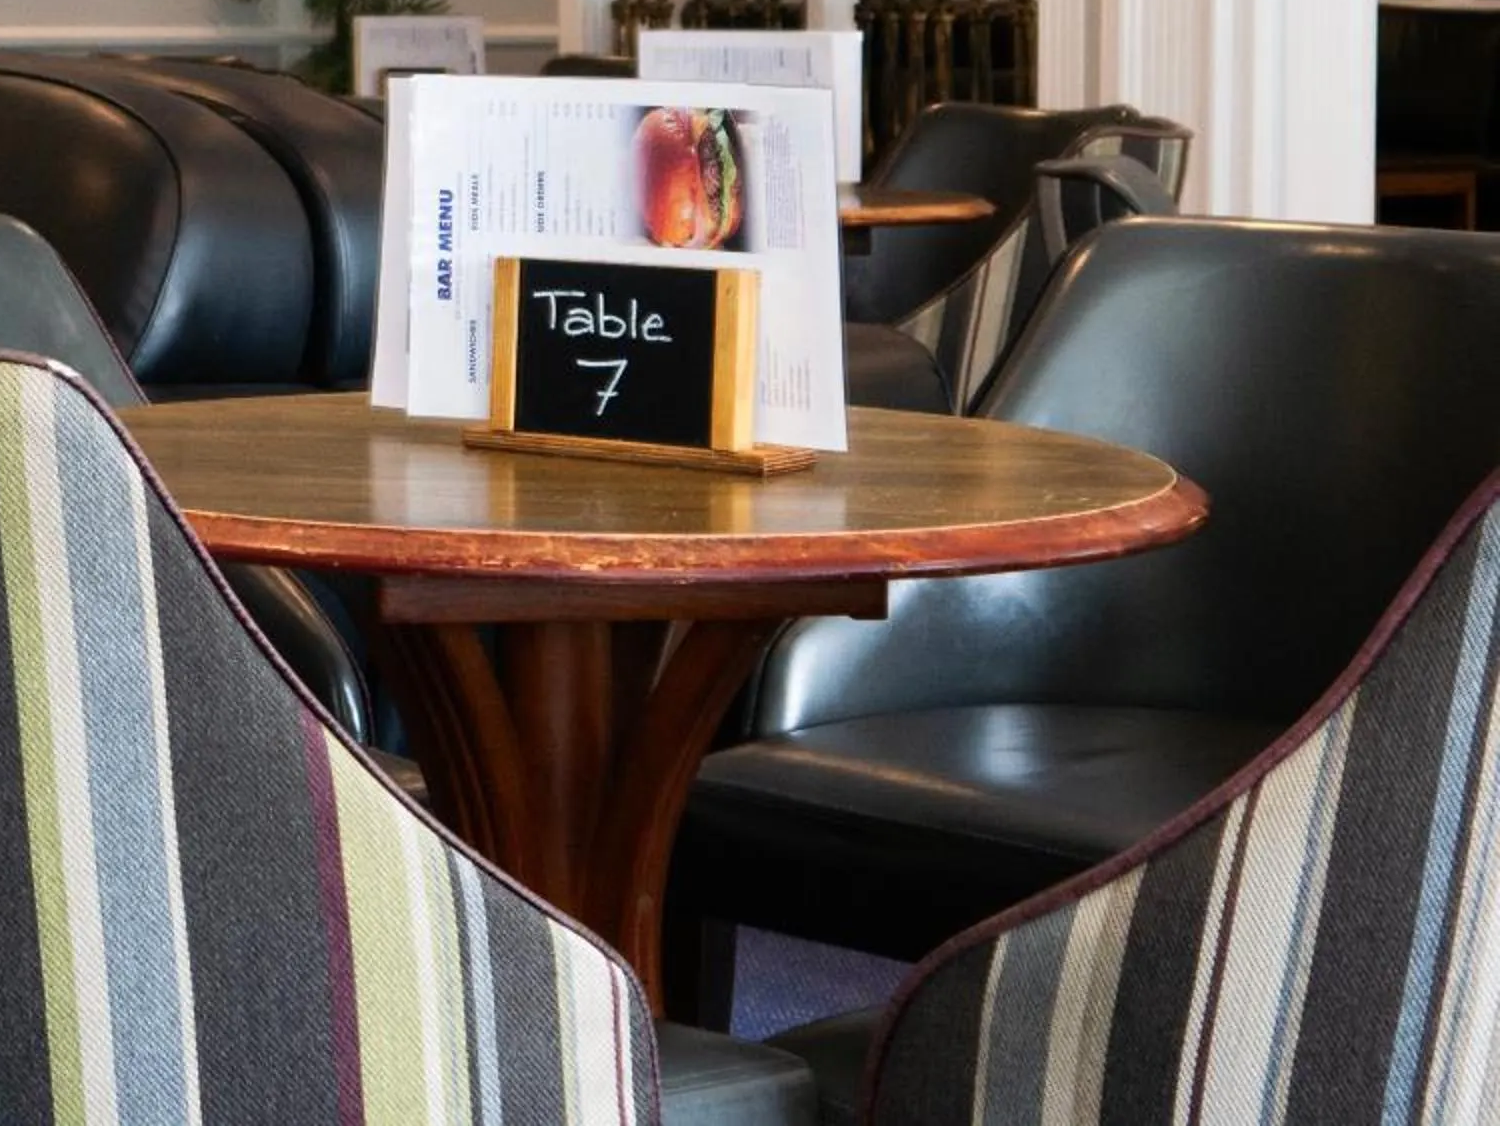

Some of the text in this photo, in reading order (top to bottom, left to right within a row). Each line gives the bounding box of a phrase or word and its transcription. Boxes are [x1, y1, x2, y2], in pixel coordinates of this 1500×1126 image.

[436, 188, 454, 301] BAR MENU
[533, 288, 673, 343] Table
[576, 359, 628, 416] 7
